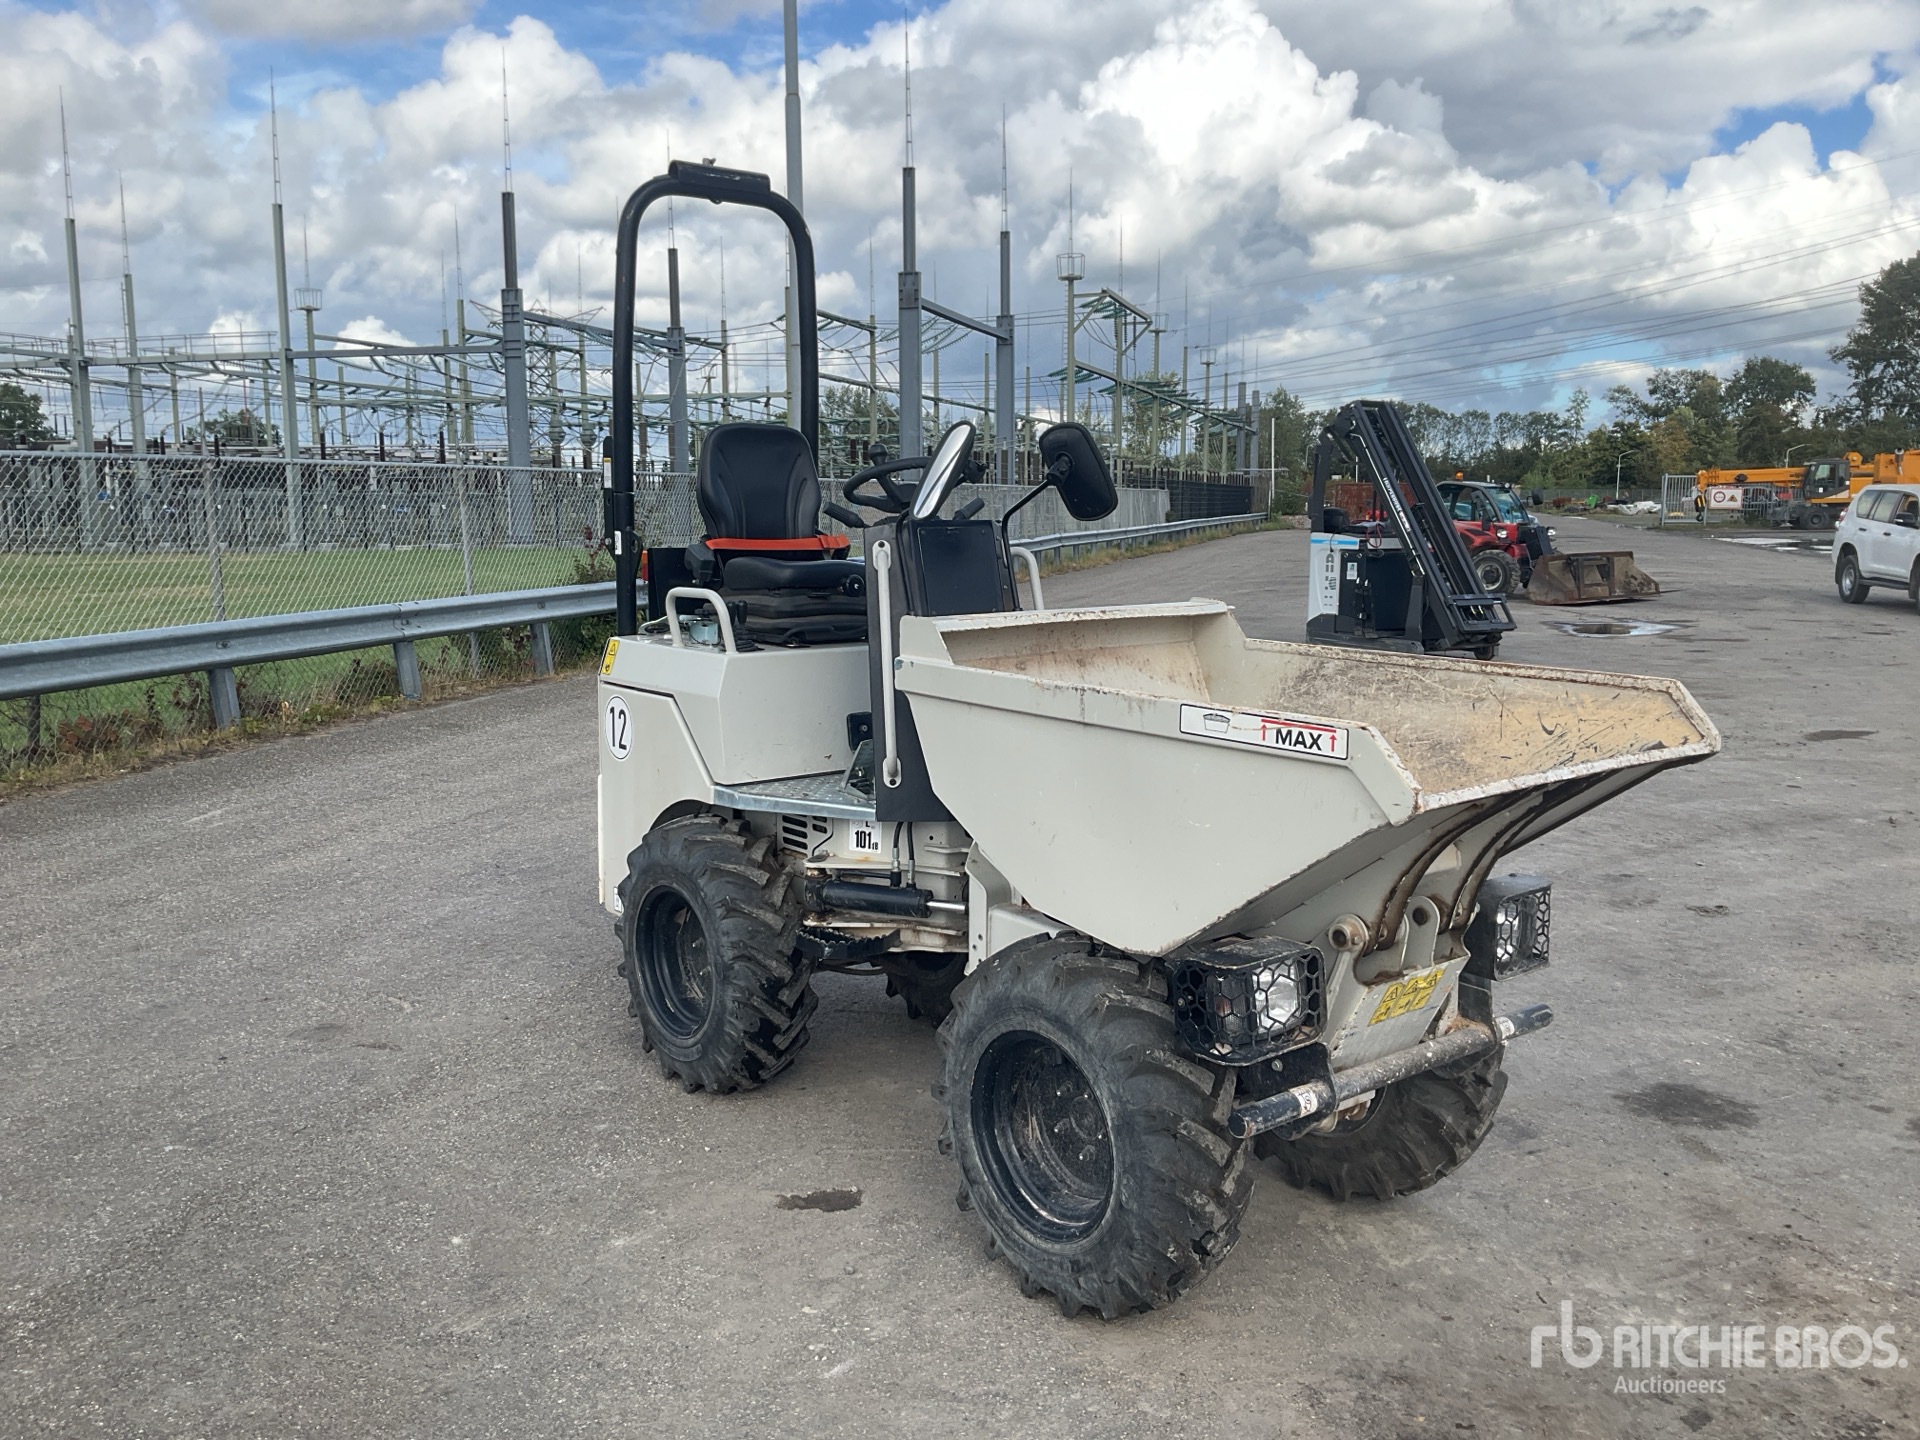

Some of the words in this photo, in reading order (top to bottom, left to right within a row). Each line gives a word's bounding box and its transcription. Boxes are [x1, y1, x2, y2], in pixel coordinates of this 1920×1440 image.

[609, 706, 627, 751] 12
[1275, 727, 1323, 751] MAX
[854, 829, 872, 850] 101
